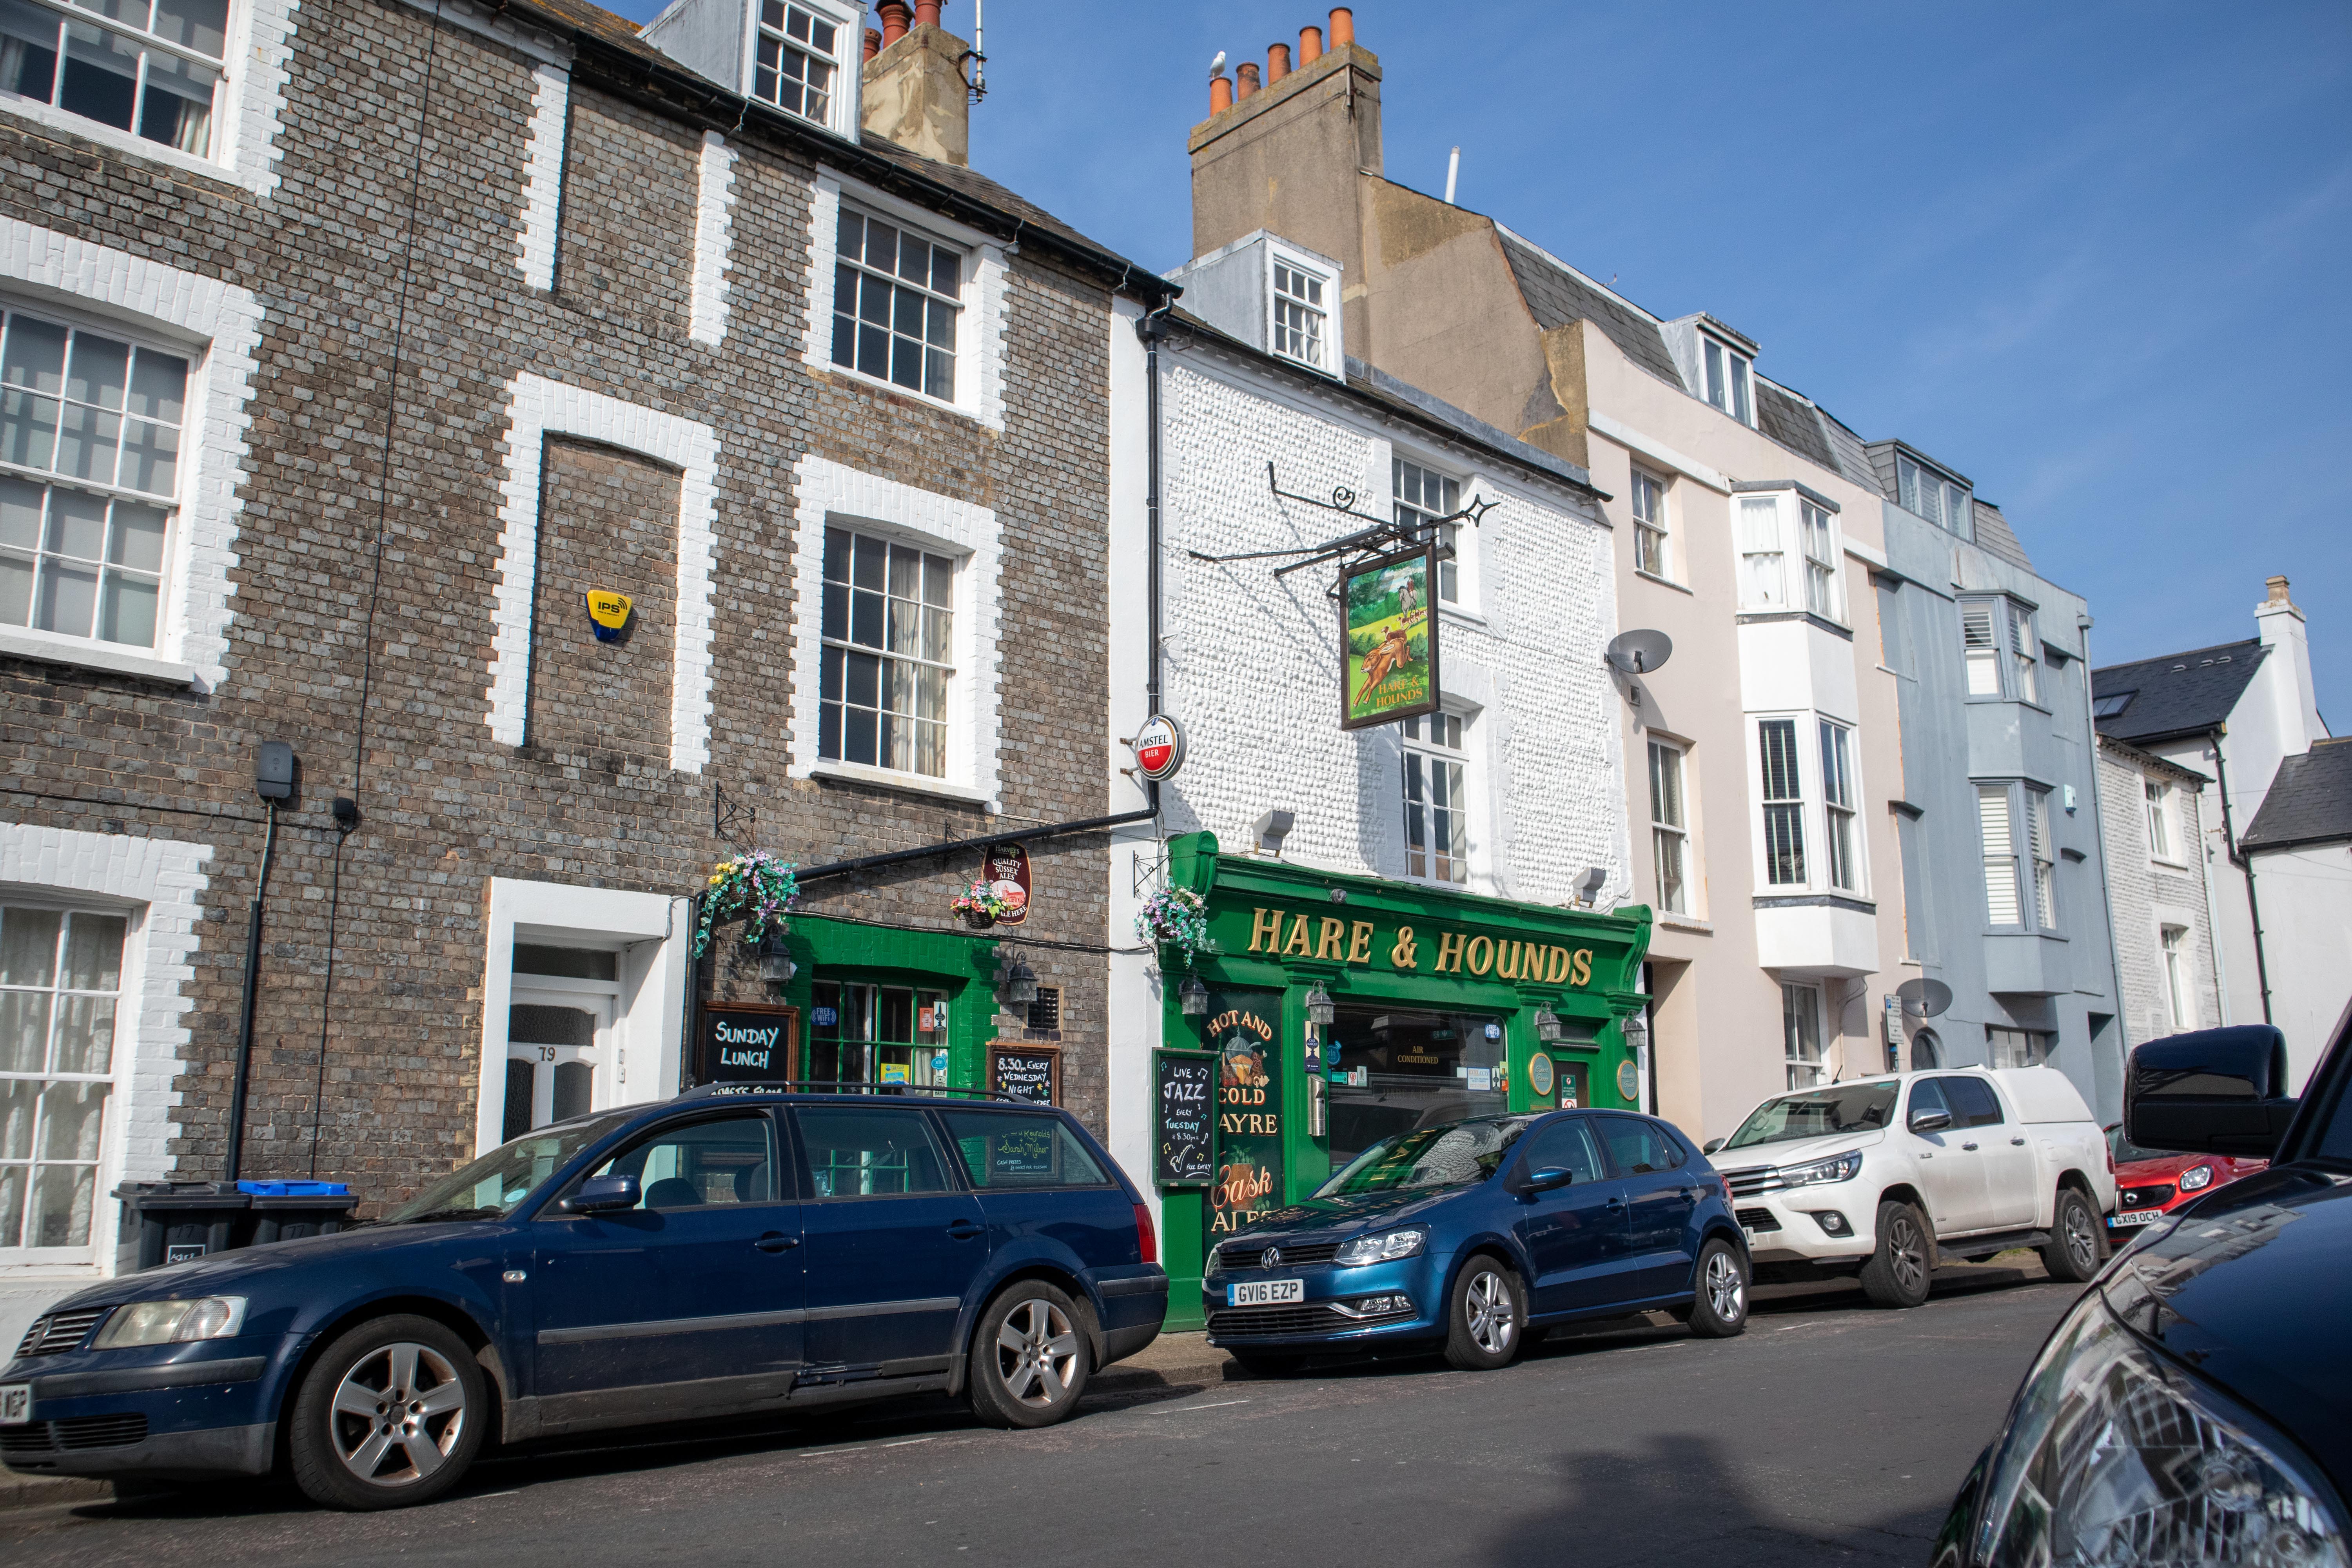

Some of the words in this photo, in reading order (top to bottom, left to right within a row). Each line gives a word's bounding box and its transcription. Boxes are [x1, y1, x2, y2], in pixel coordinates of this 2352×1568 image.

[598, 602, 620, 613] IPS
[1379, 679, 1406, 694] HARE
[1411, 676, 1419, 687] &
[1376, 688, 1423, 707] HOUNDS
[1139, 735, 1168, 749] AMSTEL
[1145, 749, 1160, 758] BIER
[995, 845, 1020, 854] HARVEYS
[993, 858, 1022, 869] QUALITY
[995, 866, 1018, 875] SUSSEX
[1012, 905, 1027, 917] HERE
[1247, 907, 1374, 963] HARE
[1391, 926, 1418, 968] &
[1434, 932, 1593, 986] HOUNDS
[1207, 1010, 1238, 1038] HOT
[1241, 1011, 1272, 1042] AND
[715, 1021, 780, 1049] SUNDAY
[539, 1047, 556, 1062] 79
[720, 1048, 769, 1069] LUNCH
[1397, 1055, 1439, 1064] CONDITIONED
[1027, 1061, 1049, 1071] EVERY
[1174, 1066, 1192, 1078] LIVE
[1004, 1071, 1047, 1082] WEDNESDAY
[1008, 1084, 1035, 1094] NIGHT
[1164, 1082, 1206, 1102] JAZZ
[1219, 1088, 1266, 1105] COLD
[1165, 1118, 1200, 1133] TUESDAY
[1219, 1113, 1278, 1136] AYRE
[998, 1140, 1027, 1156] Sarah
[1025, 1143, 1049, 1158] Milner
[1197, 1163, 1212, 1172] ENTRY
[1210, 1164, 1273, 1212] Cask
[1211, 1211, 1272, 1231] ALE
[2116, 1214, 2138, 1224] GX19
[2139, 1211, 2159, 1221] OCH
[1239, 1285, 1267, 1302] GV16
[1271, 1282, 1298, 1300] EZP
